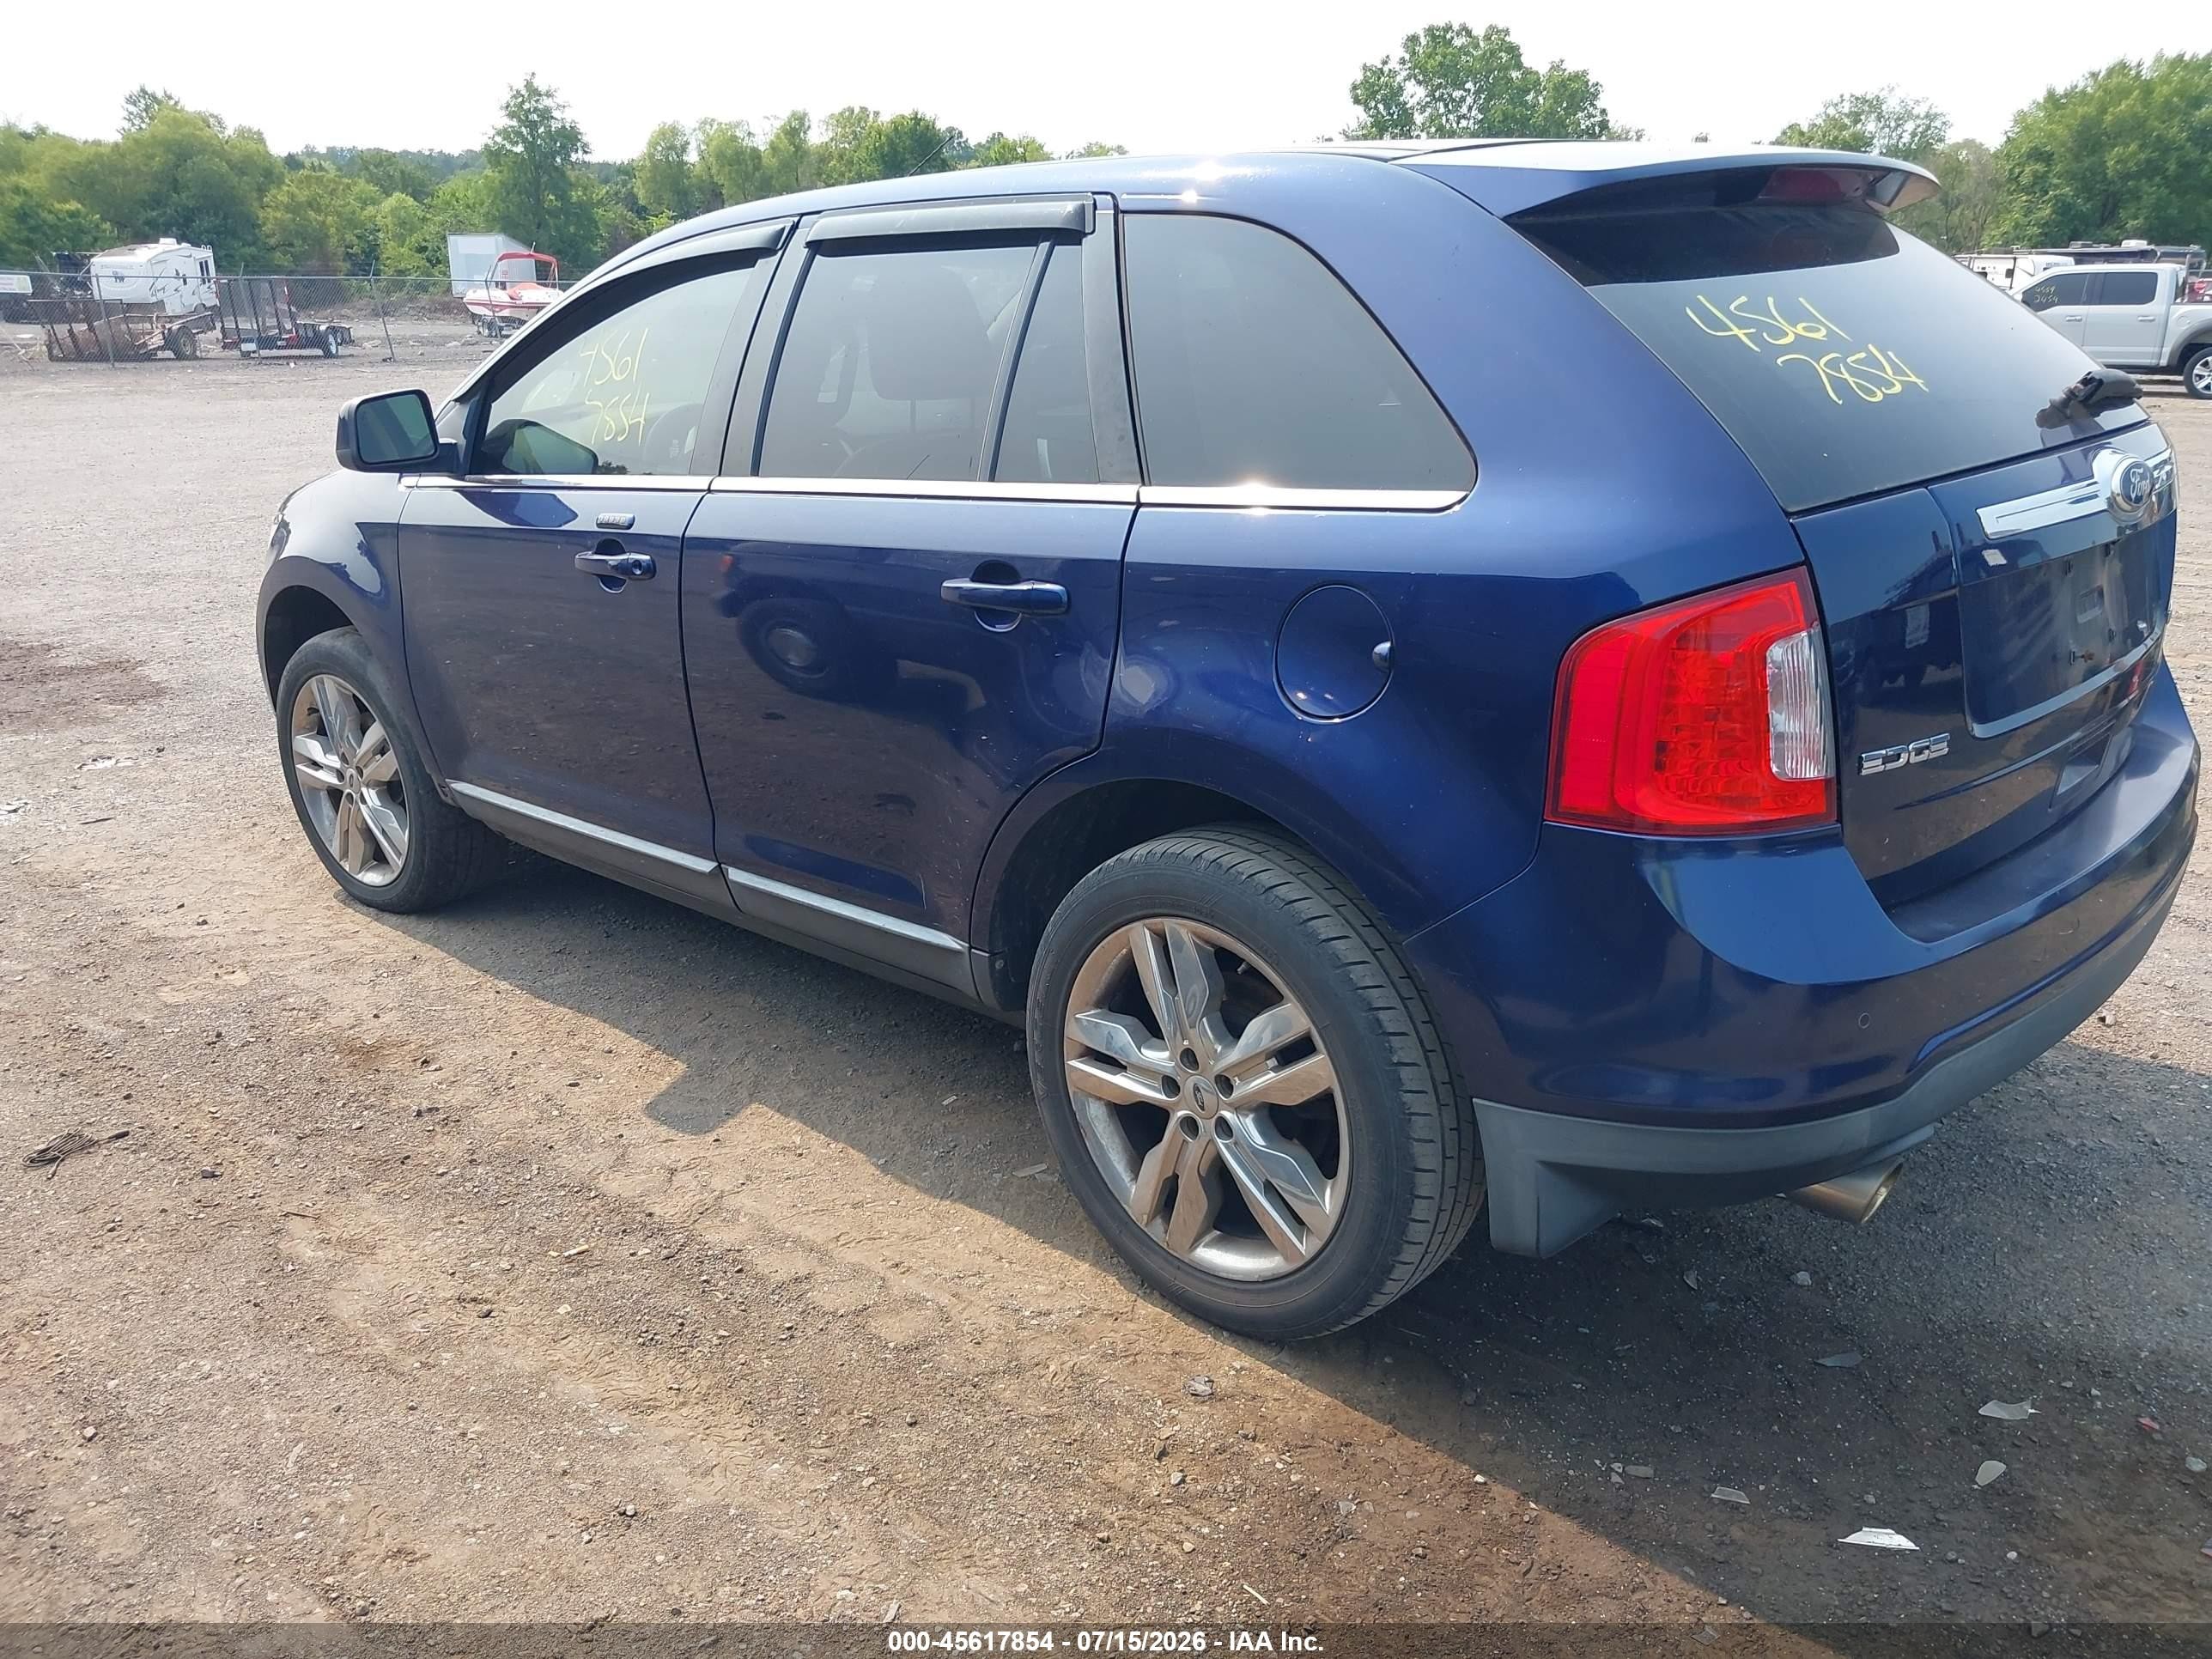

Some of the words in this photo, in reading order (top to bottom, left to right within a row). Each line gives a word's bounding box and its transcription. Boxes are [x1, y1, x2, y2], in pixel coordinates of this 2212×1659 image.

[1686, 295, 1852, 352] 4561
[1777, 343, 1929, 404] 7854
[1858, 732, 1950, 775] EDGE
